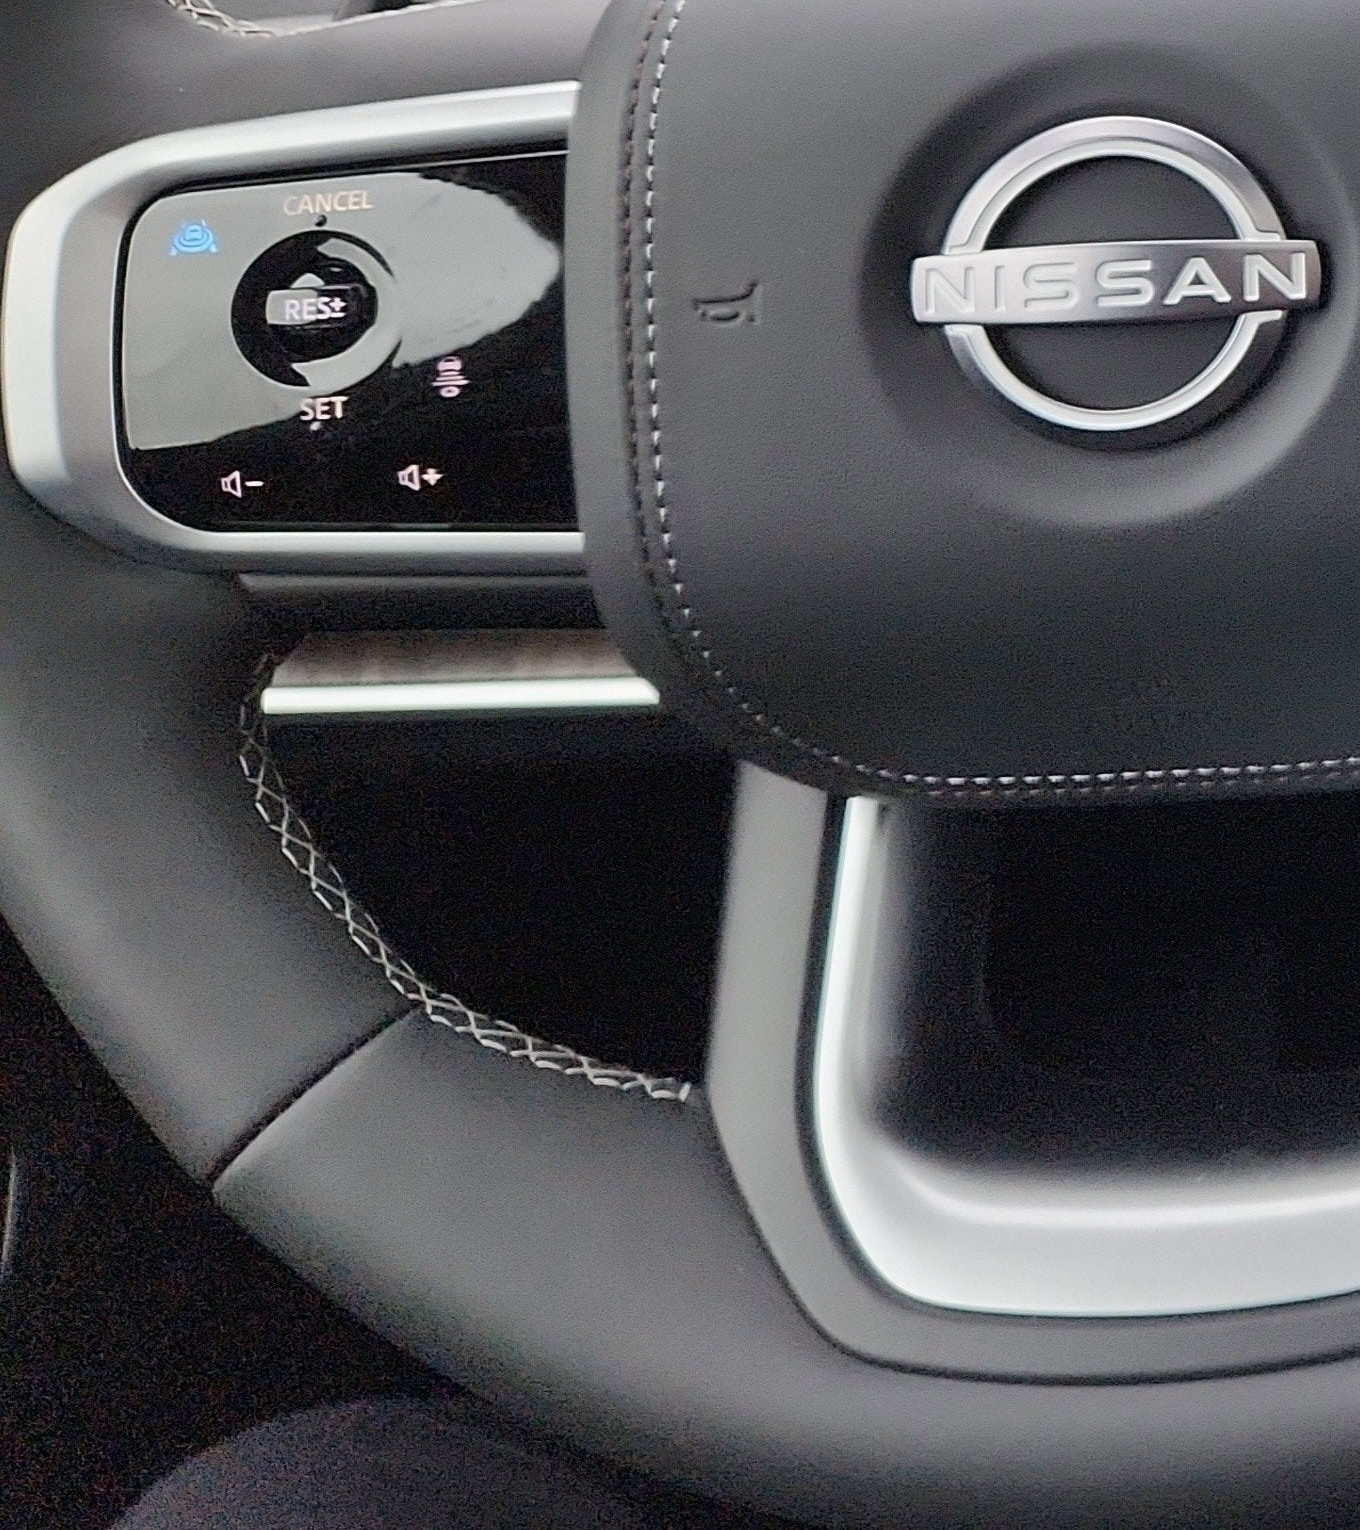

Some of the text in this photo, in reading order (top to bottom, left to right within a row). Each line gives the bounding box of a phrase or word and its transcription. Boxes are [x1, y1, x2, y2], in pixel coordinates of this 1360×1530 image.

[283, 190, 375, 216] CANCEL
[923, 252, 1308, 316] NISSAN
[300, 396, 348, 422] SET
